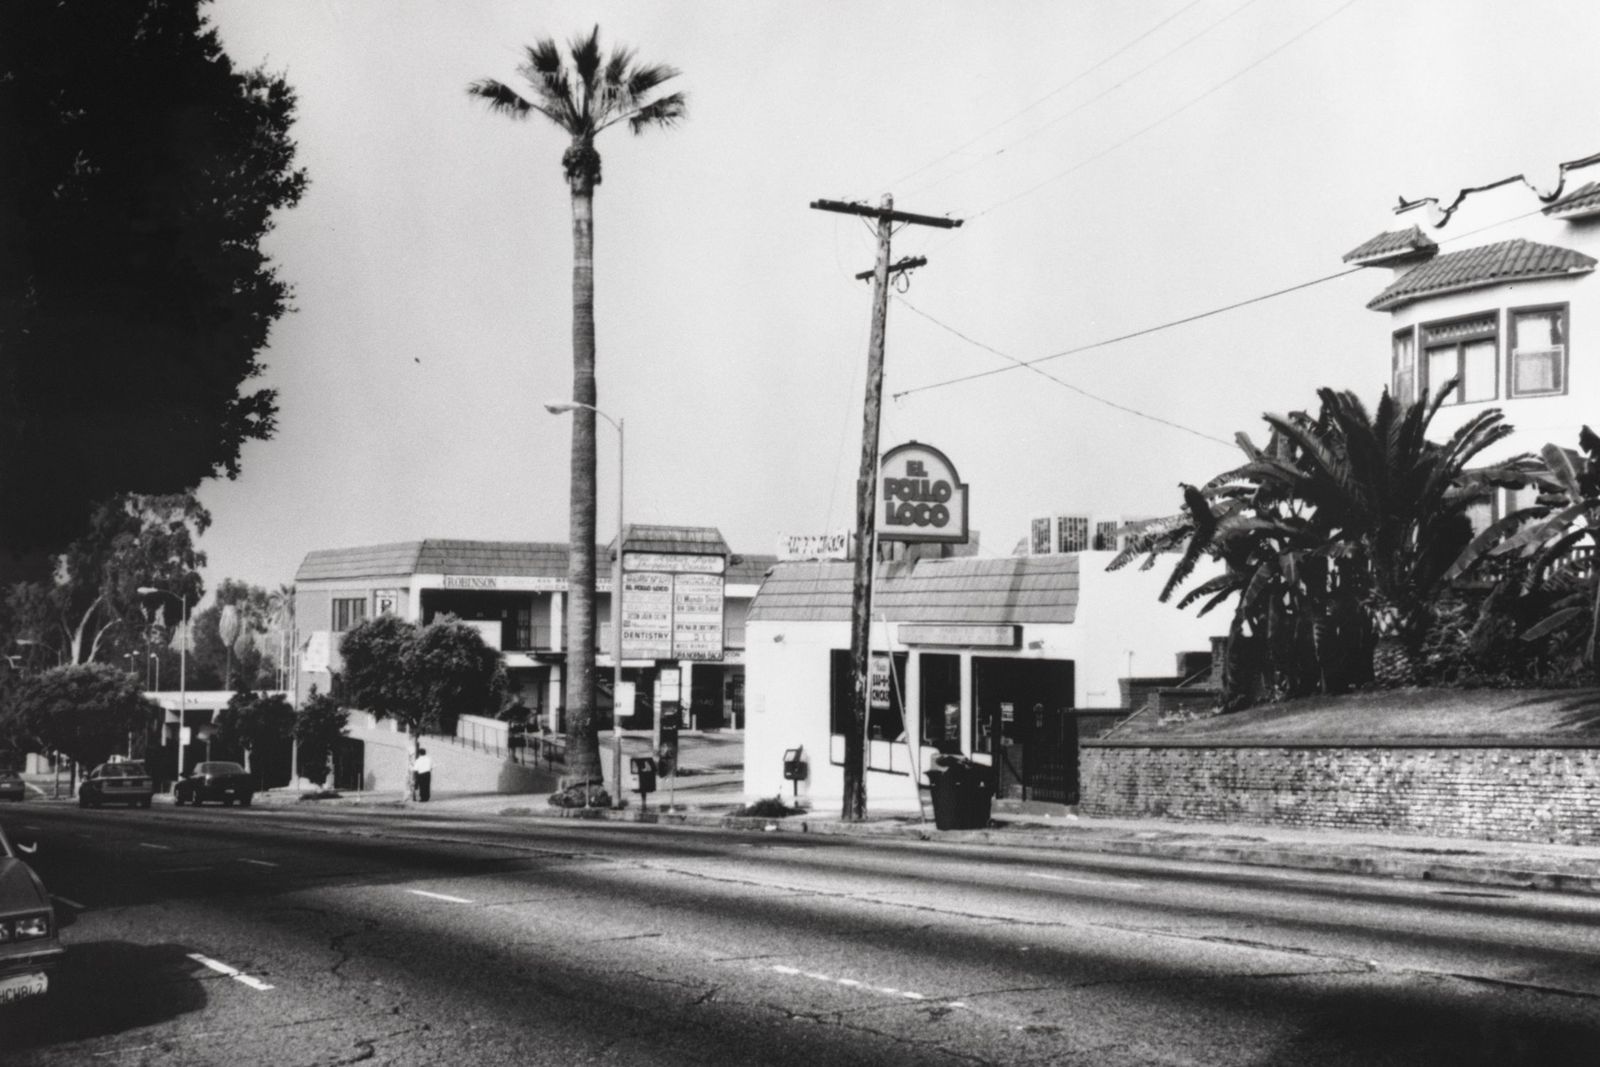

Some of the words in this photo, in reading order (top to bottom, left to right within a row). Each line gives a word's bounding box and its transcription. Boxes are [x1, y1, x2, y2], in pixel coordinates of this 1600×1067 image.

[906, 460, 928, 477] EL
[884, 477, 952, 503] POLLO
[885, 502, 950, 528] LOCO
[446, 576, 497, 589] ROBINSON
[623, 631, 669, 639] DENTISTRY
